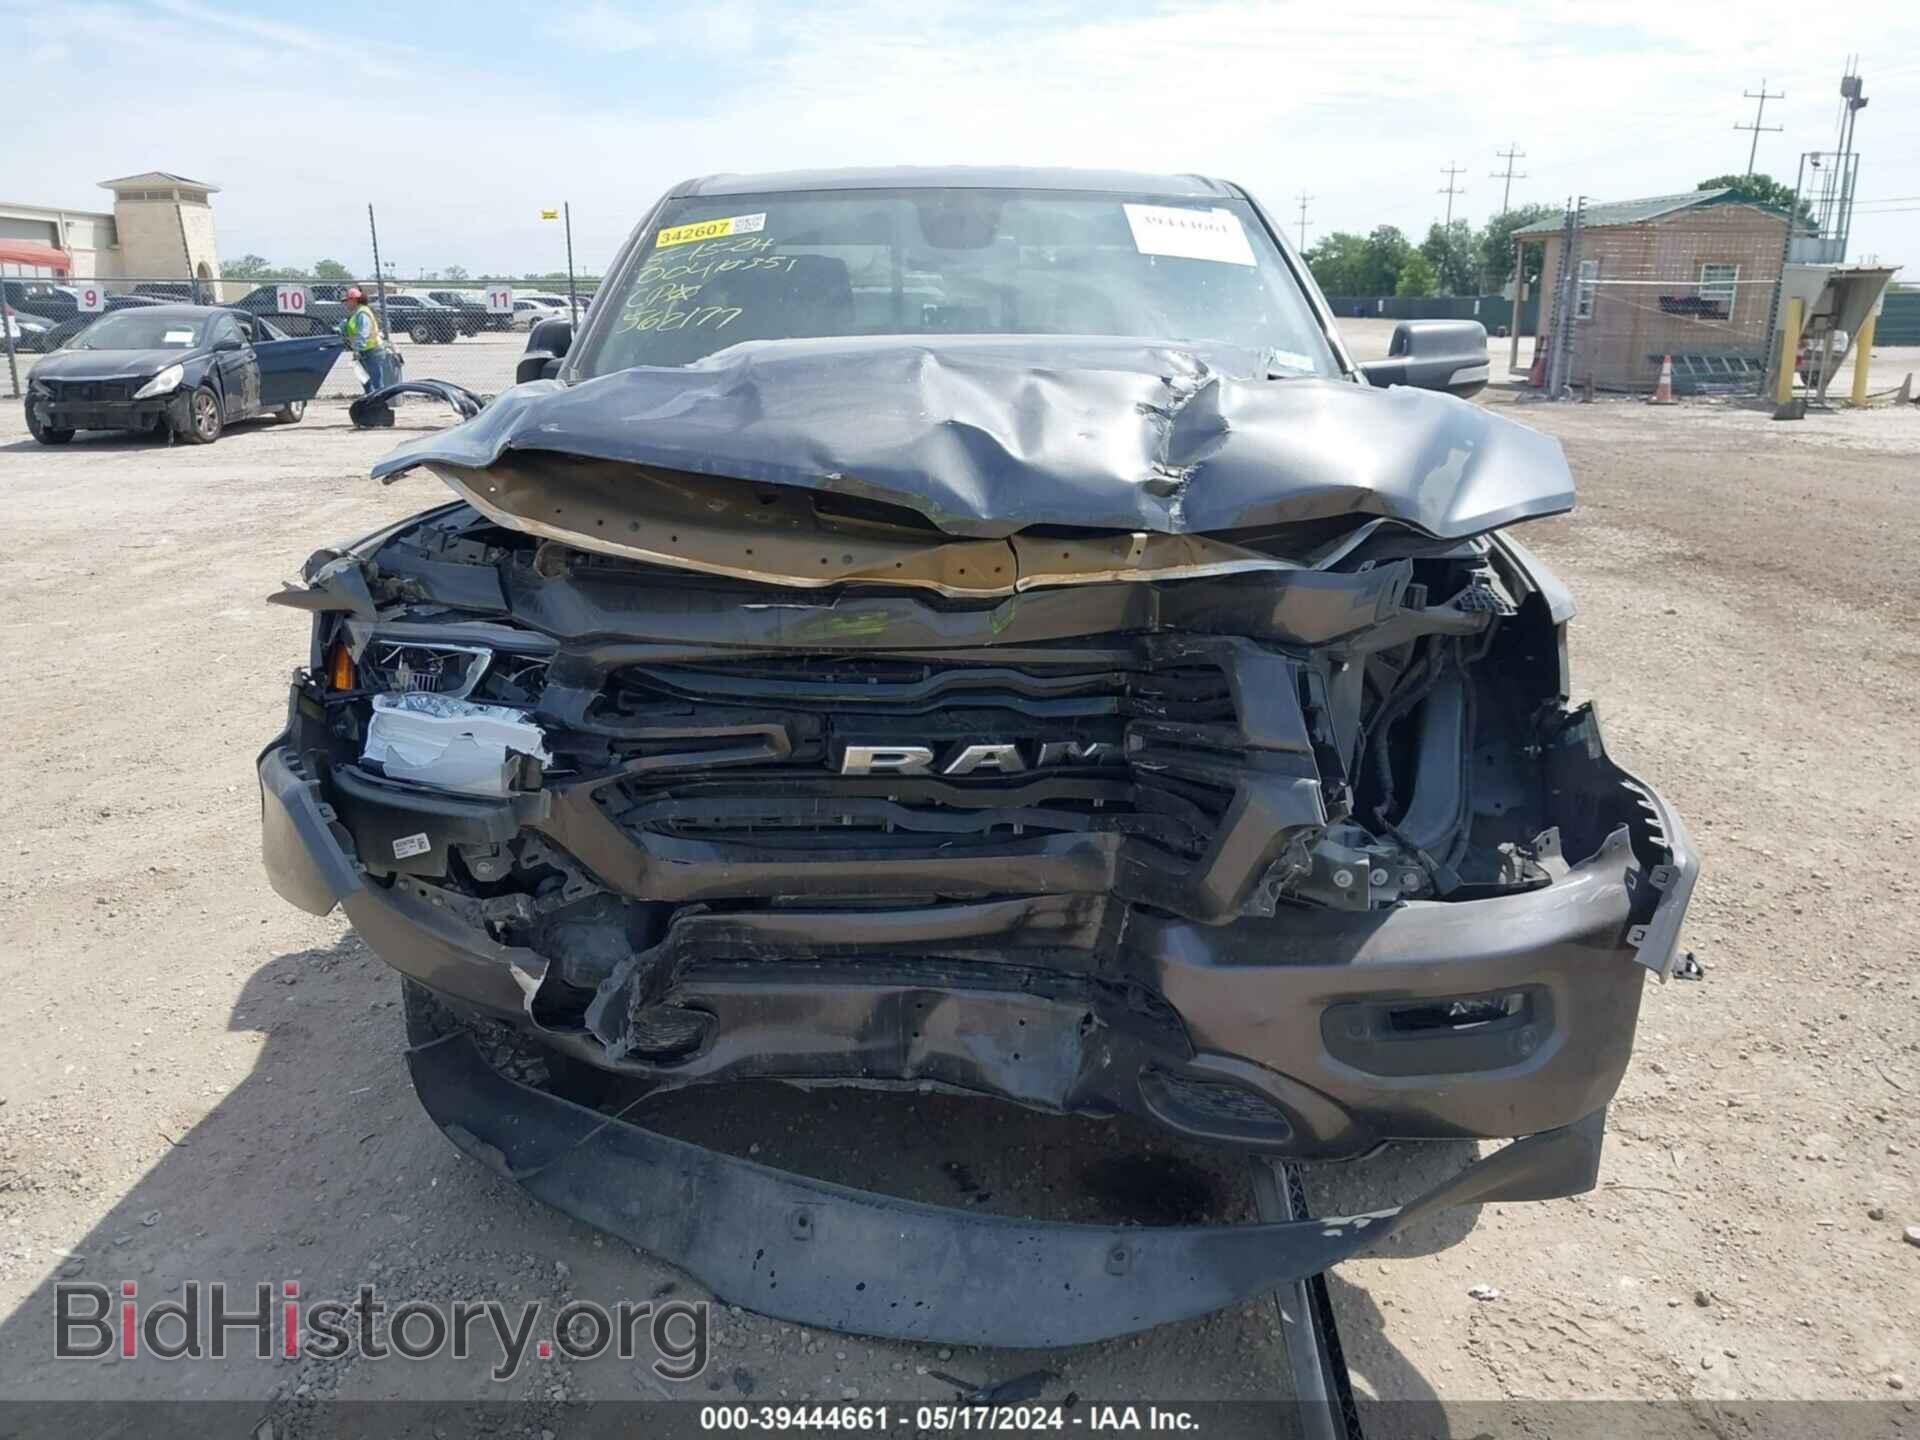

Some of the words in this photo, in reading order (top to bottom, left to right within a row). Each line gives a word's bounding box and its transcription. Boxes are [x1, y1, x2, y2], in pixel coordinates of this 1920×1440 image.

[660, 221, 731, 245] 342607
[85, 290, 97, 307] 9
[279, 292, 304, 310] 10
[490, 292, 508, 308] 11
[841, 742, 1112, 775] RAM
